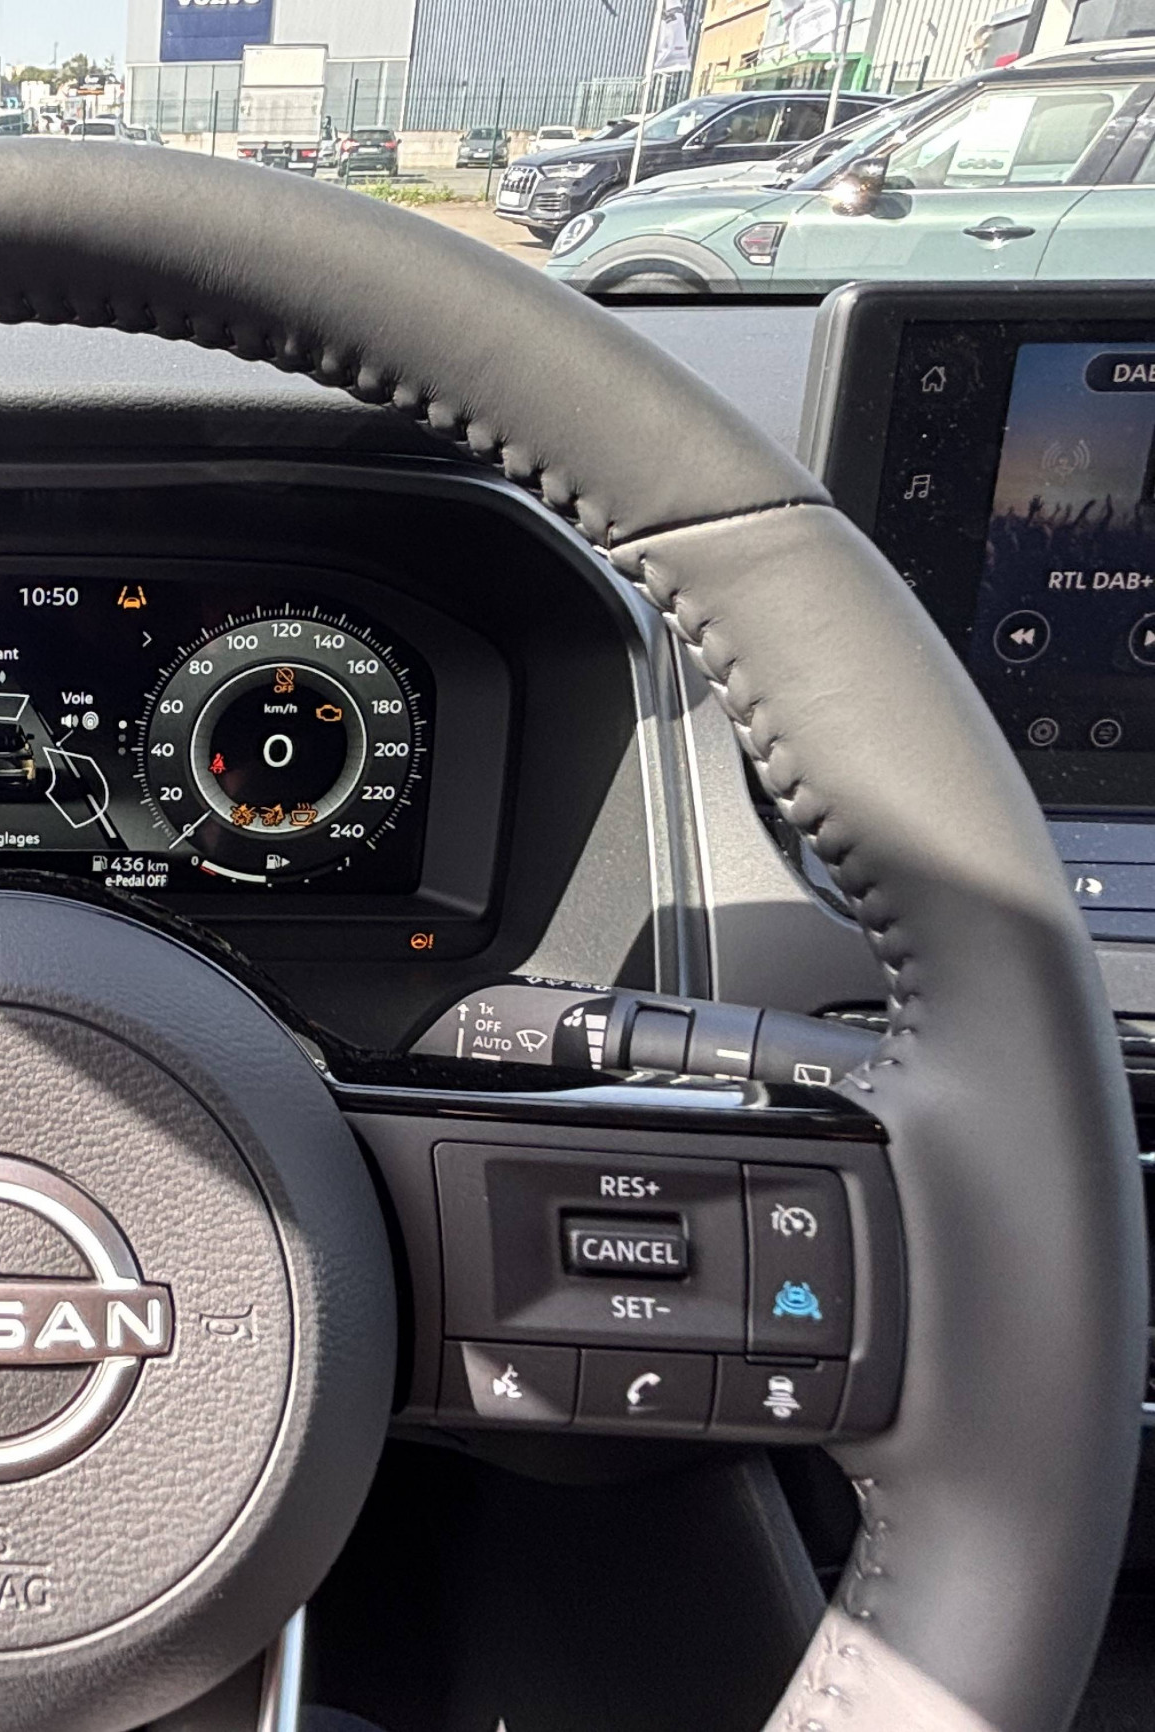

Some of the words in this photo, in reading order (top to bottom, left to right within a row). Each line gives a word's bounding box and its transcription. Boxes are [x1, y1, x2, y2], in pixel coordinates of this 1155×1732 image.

[1048, 572, 1087, 589] RTL
[1092, 571, 1153, 589] DAB+
[19, 587, 79, 606] 10:50
[271, 623, 302, 638] 120
[226, 635, 258, 650] 100
[313, 635, 345, 649] 140
[189, 661, 213, 675] 80
[347, 660, 379, 674] 160
[273, 684, 295, 694] OFF
[61, 691, 94, 705] Voie
[159, 700, 184, 714] 60
[264, 702, 298, 715] km/h
[371, 700, 403, 714] 180
[150, 743, 175, 758] 40
[263, 734, 294, 768] 0
[374, 743, 409, 757] 200
[159, 786, 183, 801] 20
[362, 786, 395, 800] 220
[330, 823, 364, 838] 240
[110, 857, 144, 872] 436
[147, 858, 169, 872] km
[105, 874, 145, 887] e-Pedal
[146, 874, 167, 887] OFF
[479, 1003, 494, 1015] 1x
[474, 1020, 502, 1033] OFF
[473, 1036, 512, 1051] AUTO
[600, 1175, 661, 1198] RES+
[582, 1238, 679, 1266] CANCEL
